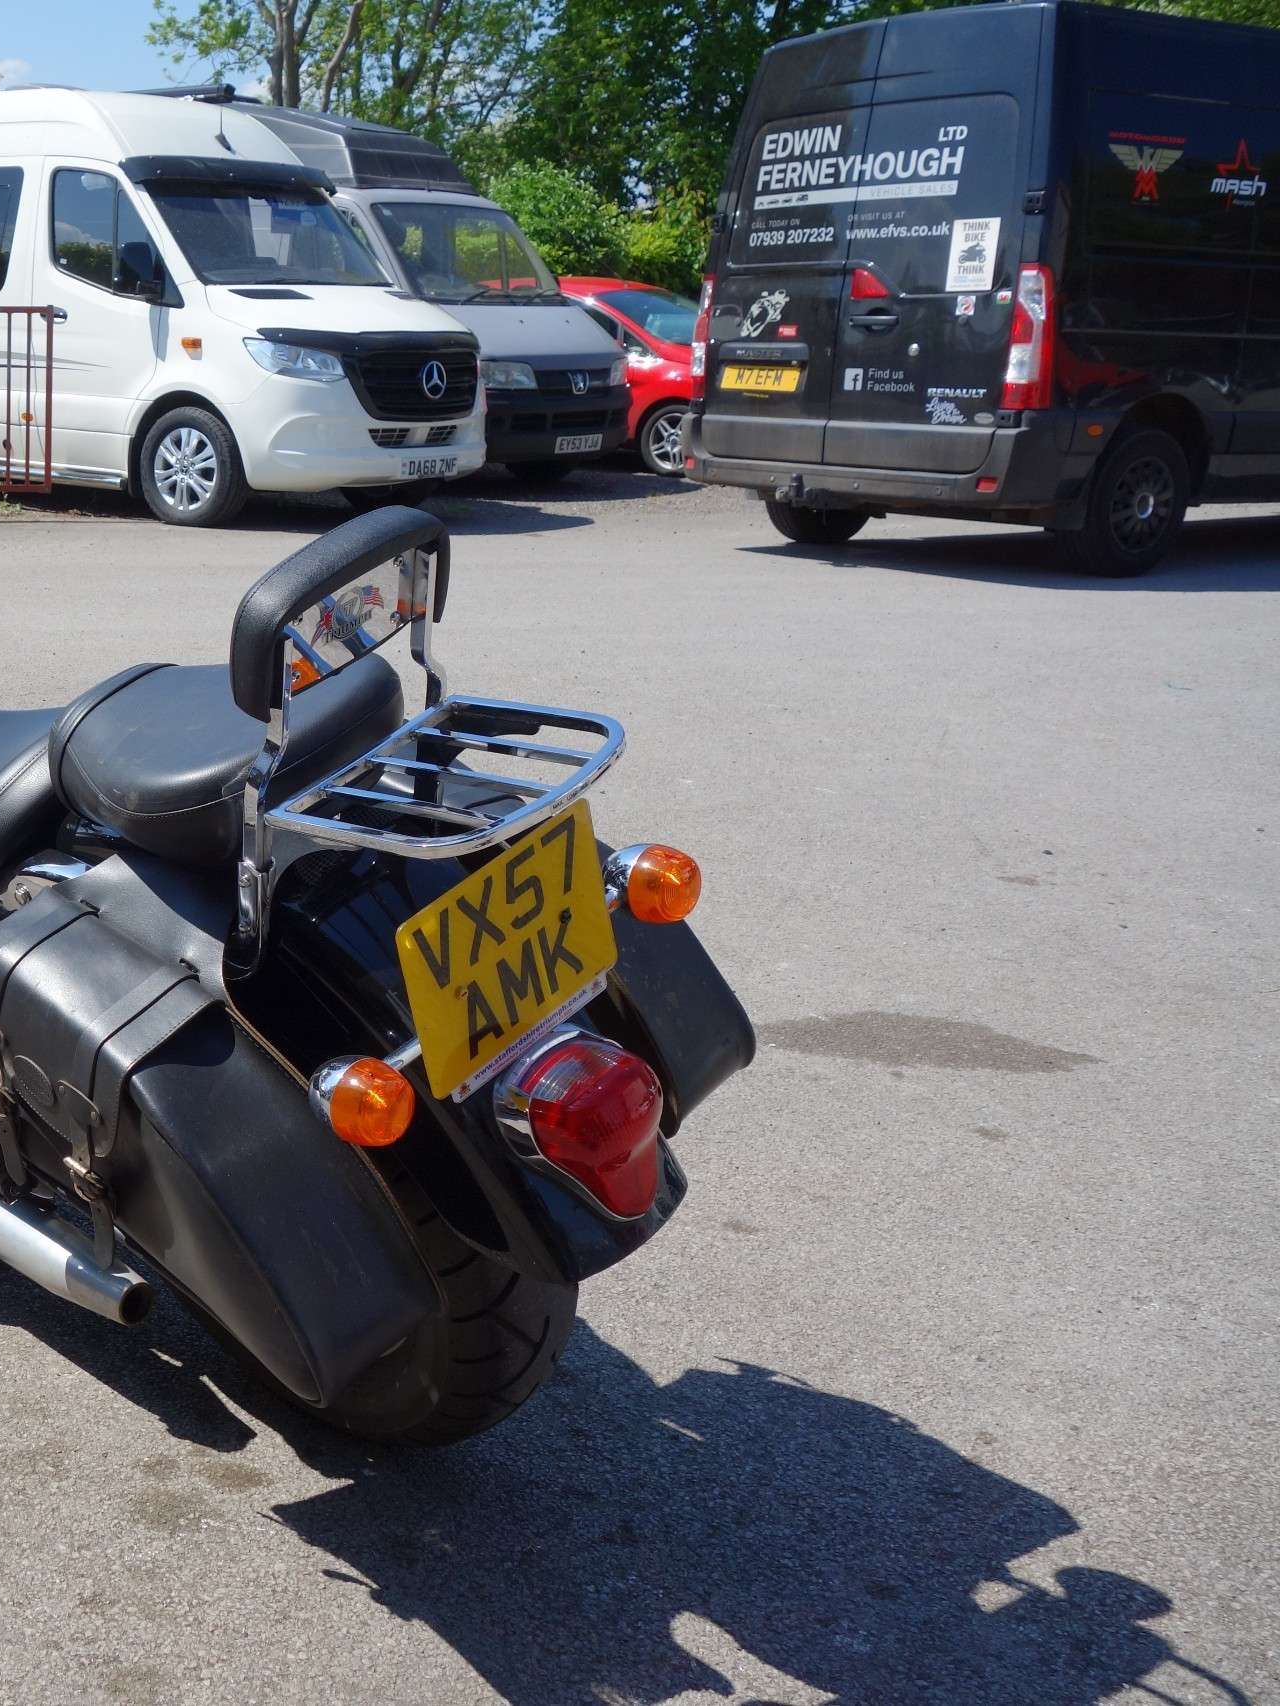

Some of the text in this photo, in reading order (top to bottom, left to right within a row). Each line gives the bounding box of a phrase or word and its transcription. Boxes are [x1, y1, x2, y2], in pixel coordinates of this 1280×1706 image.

[938, 125, 968, 142] LTD
[762, 124, 842, 160] EDWIN
[756, 146, 965, 192] FERNEYHOUGH
[871, 183, 955, 198] VEHICLE SALES
[848, 210, 906, 222] OR VISIT US AT
[751, 218, 801, 230] CALL TODAY ON
[846, 221, 950, 240] www.efvs.co.uk
[963, 221, 991, 232] THINK
[749, 227, 835, 247] 07939 207232
[965, 232, 986, 242] BIKE
[958, 265, 985, 275] THINK
[735, 368, 754, 385] M7
[868, 368, 904, 379] Find us
[867, 381, 915, 393] Facebook
[927, 388, 987, 399] RENAULT
[439, 457, 458, 473] ZNF
[411, 814, 577, 990] VX57
[466, 908, 584, 1060] AMK
